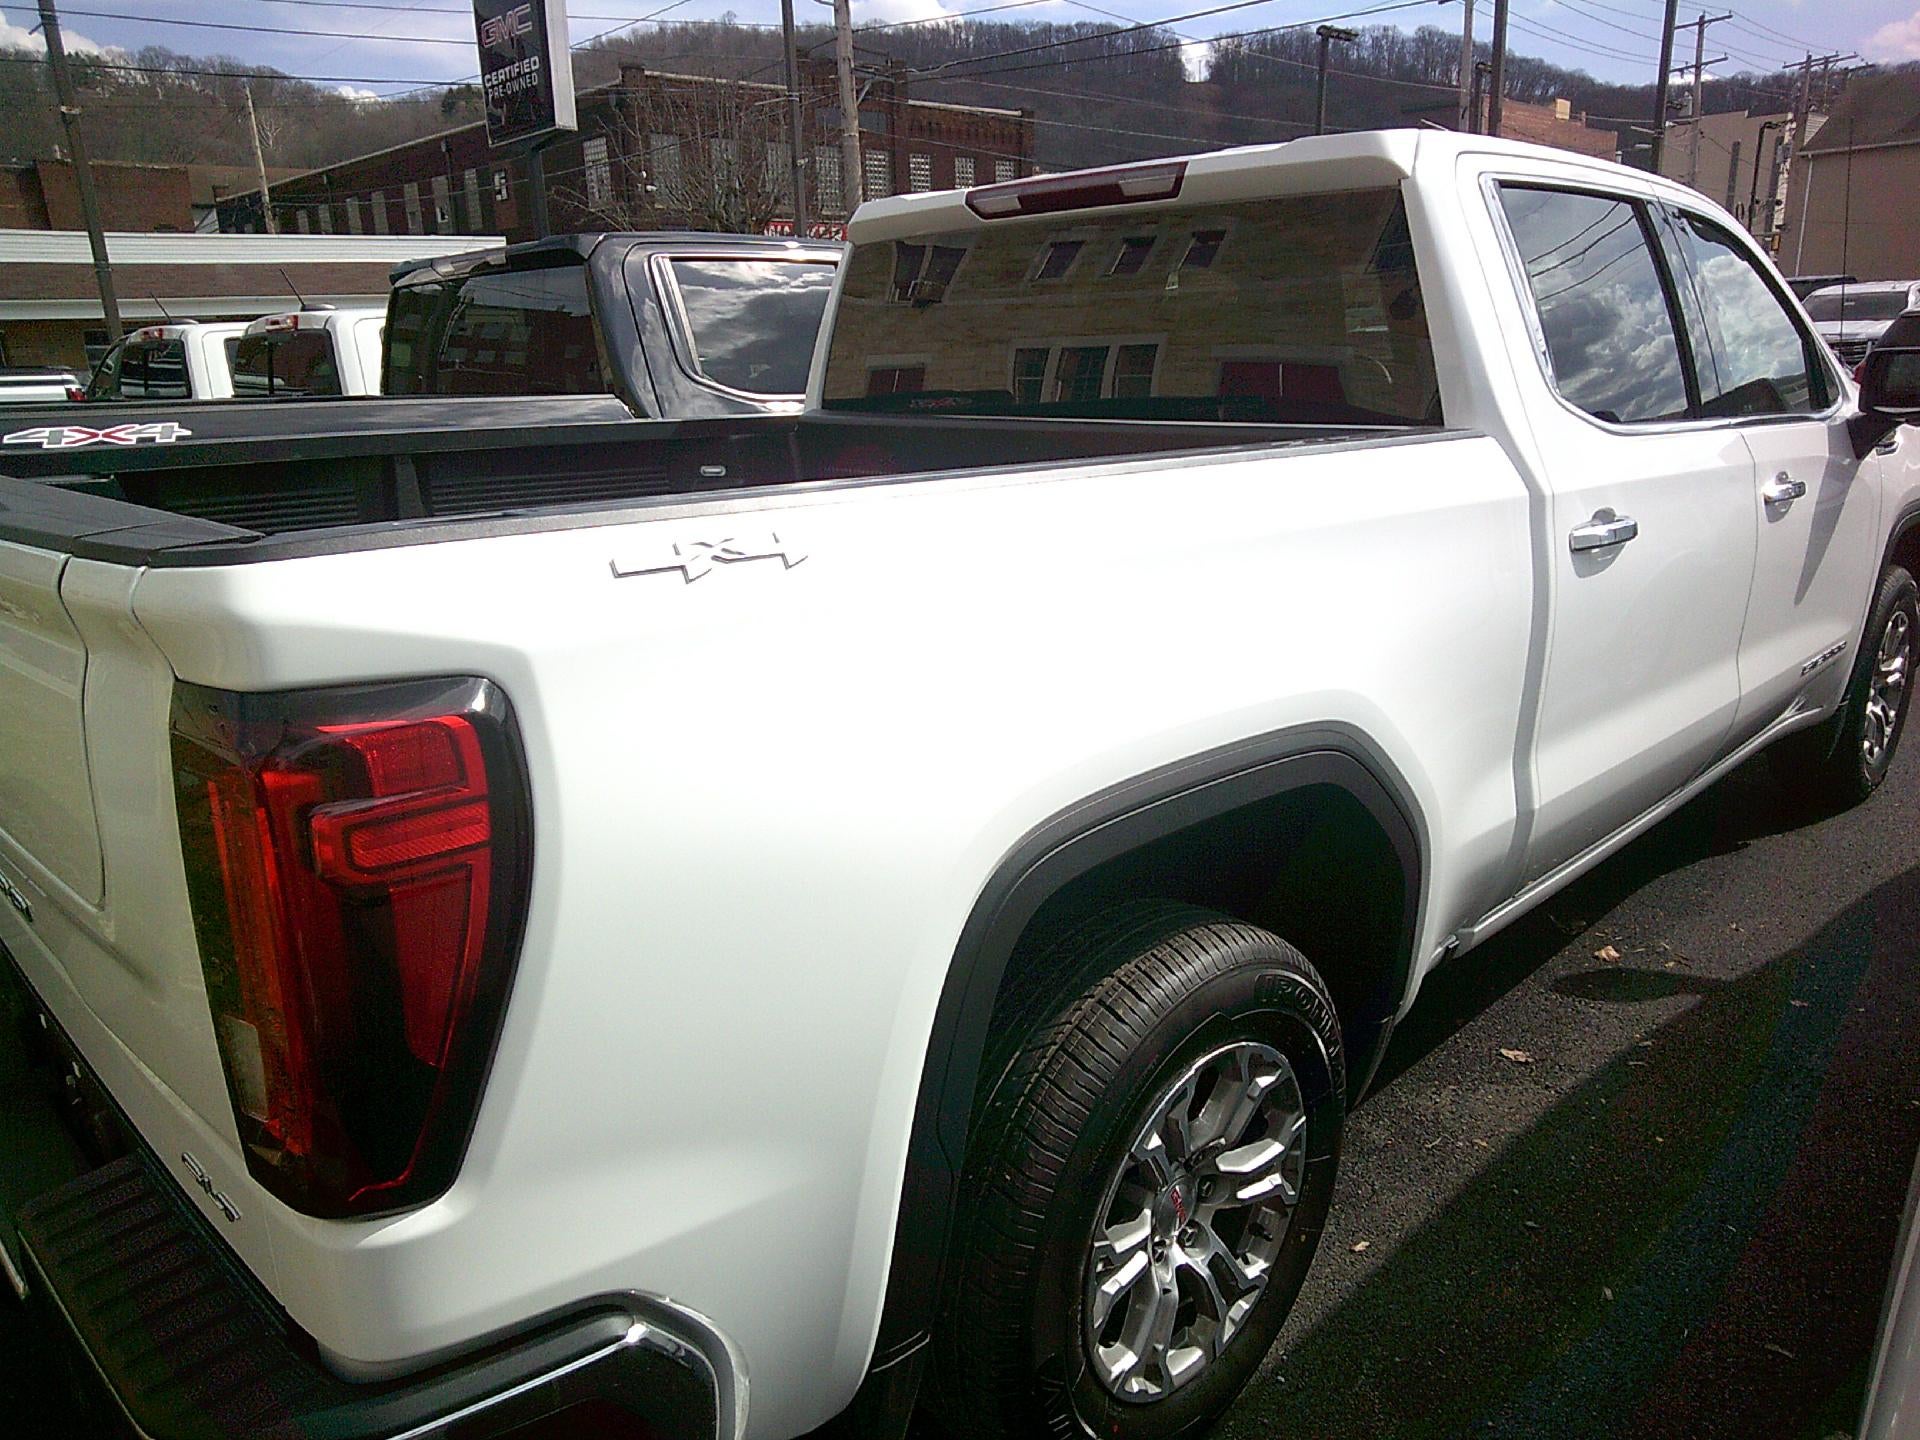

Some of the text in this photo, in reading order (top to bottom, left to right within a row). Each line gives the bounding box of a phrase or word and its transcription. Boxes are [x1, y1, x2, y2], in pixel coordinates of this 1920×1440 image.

[480, 3, 533, 48] GMC
[484, 55, 540, 88] CERTIFIED
[488, 73, 538, 101] PRE-OWNED
